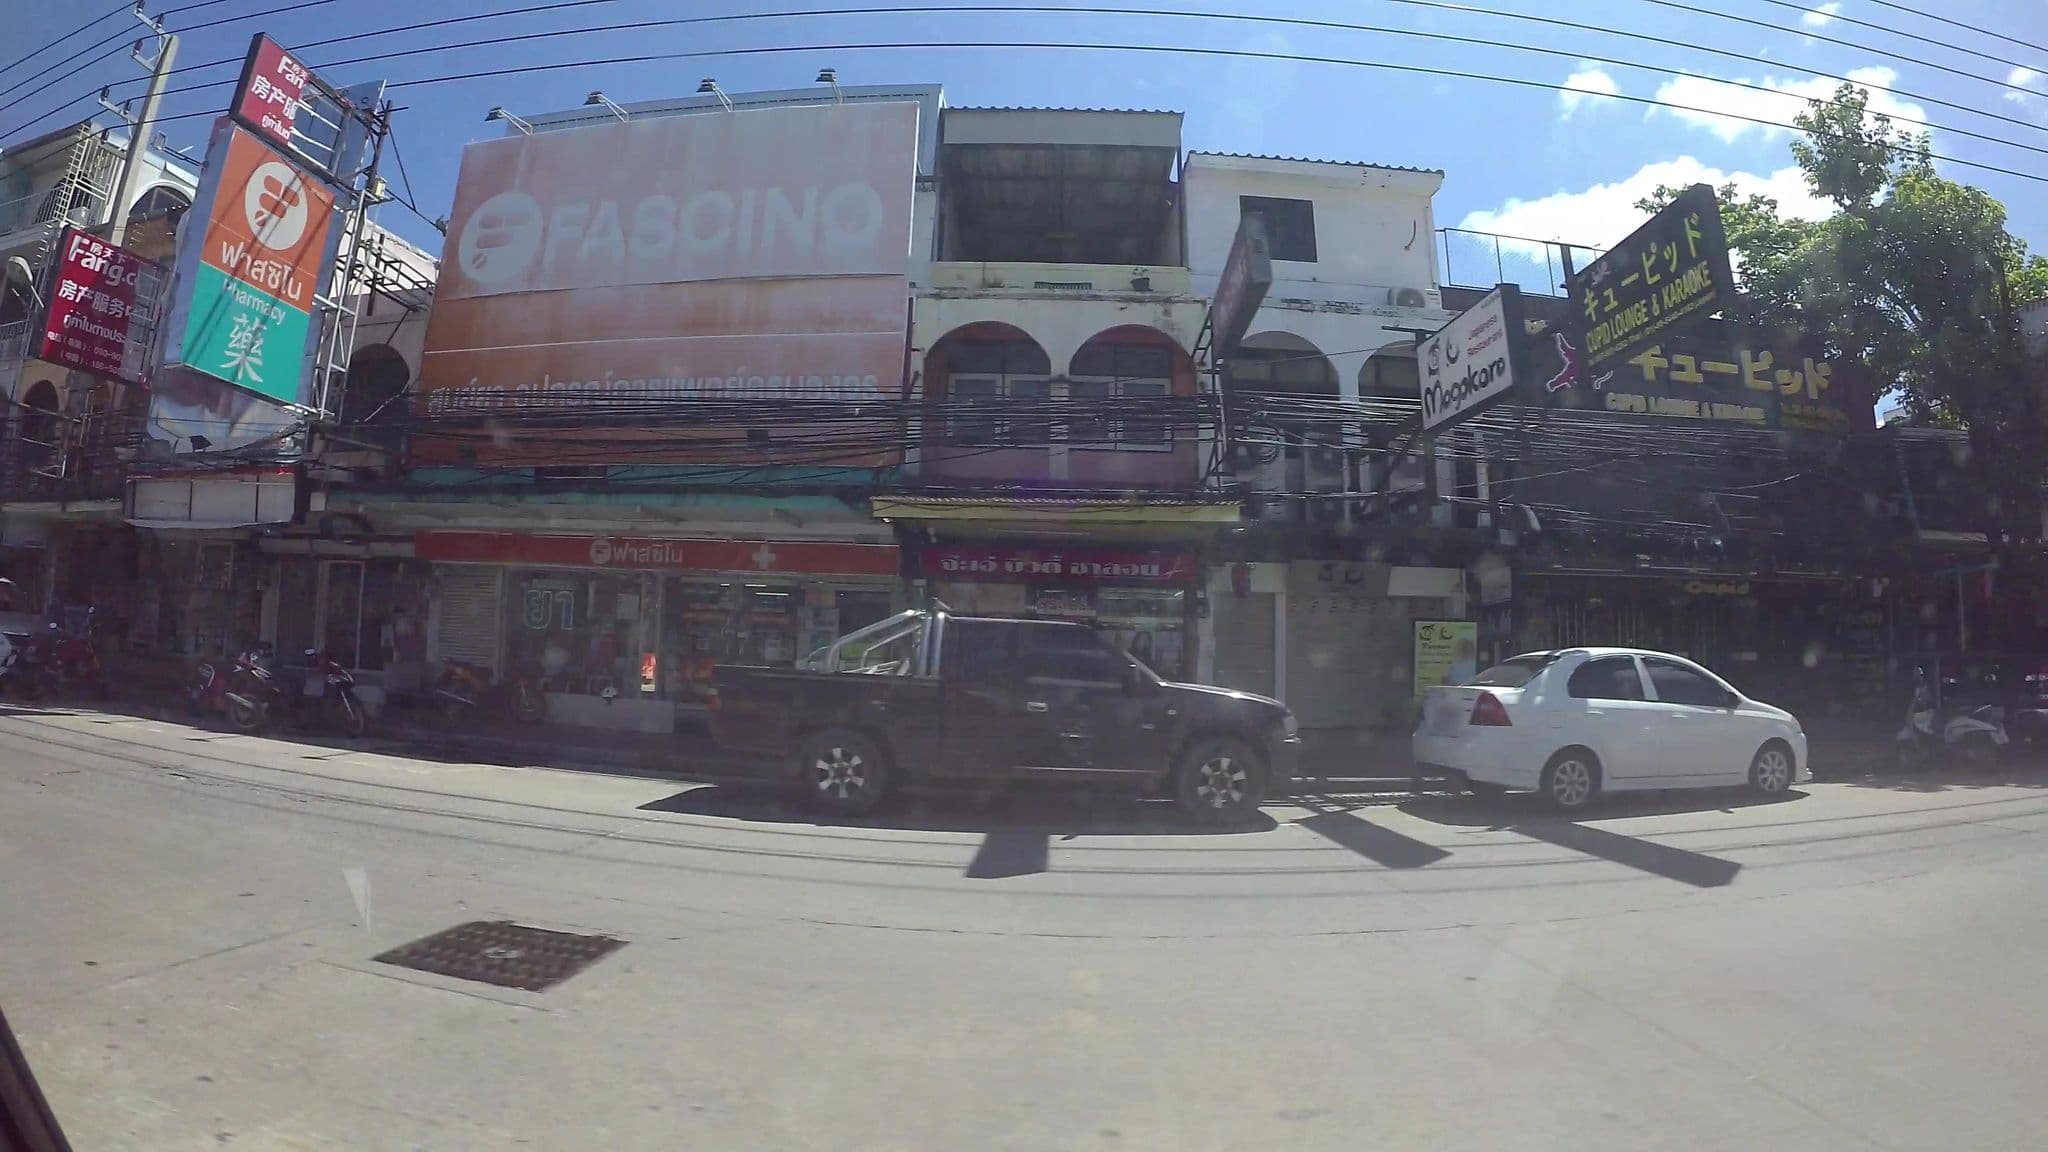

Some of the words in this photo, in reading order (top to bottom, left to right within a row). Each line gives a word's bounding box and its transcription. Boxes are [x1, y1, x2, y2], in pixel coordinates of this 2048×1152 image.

[542, 183, 884, 267] FASCINO
[58, 278, 133, 318] 房产服务
[221, 238, 303, 302] ฟาสซิโน
[1583, 211, 1703, 323] キューピッド
[223, 277, 287, 325] Pharmacy
[1586, 322, 1612, 353] CUPID
[1610, 299, 1649, 339] LOUNGE
[1651, 293, 1661, 317] &
[1661, 259, 1713, 310] KARAOKE
[613, 542, 684, 564] ฟาสซิโน
